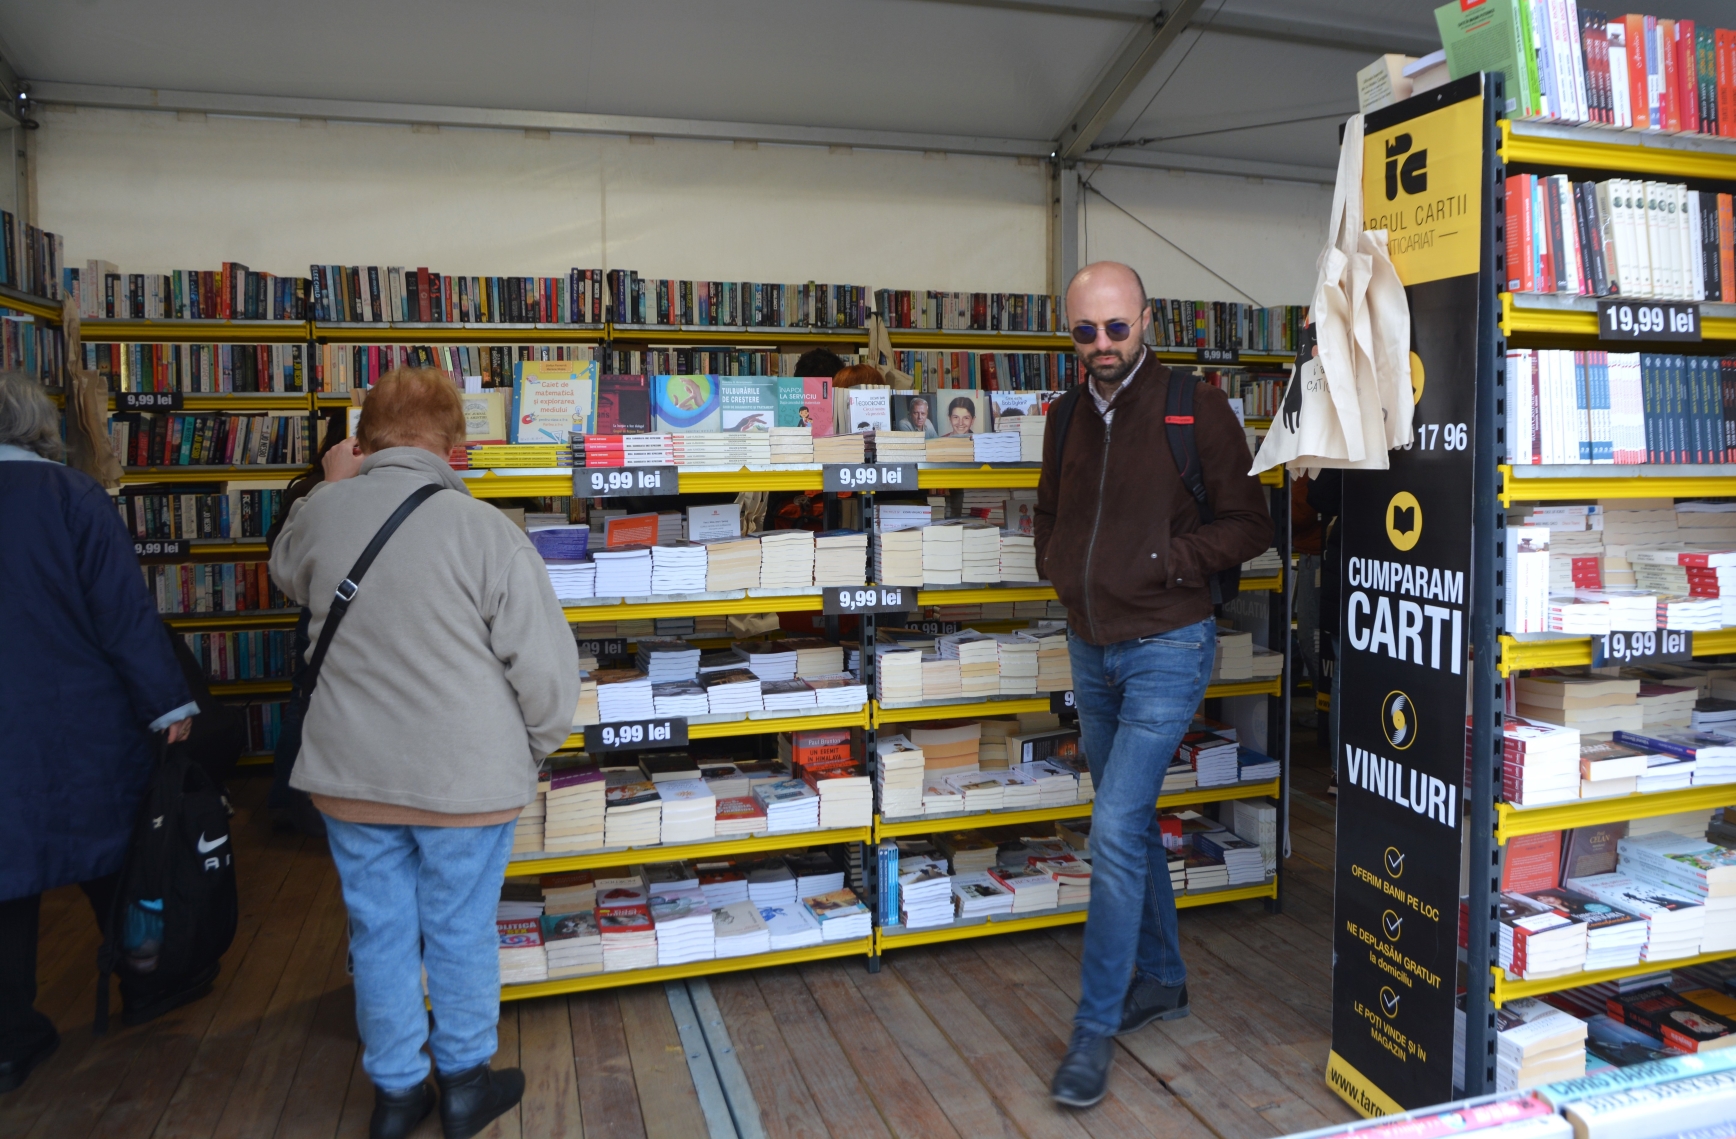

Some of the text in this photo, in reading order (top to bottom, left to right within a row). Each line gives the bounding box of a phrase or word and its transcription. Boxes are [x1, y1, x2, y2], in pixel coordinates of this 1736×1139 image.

[1362, 193, 1468, 233] ARGUL CARTII
[1388, 228, 1435, 256] NTICARIAT
[1606, 305, 1694, 336] 19,99 lei
[1204, 350, 1232, 360] 9,99 lei
[127, 394, 172, 406] 9,99 lei
[540, 398, 575, 406] explorarea
[722, 386, 760, 395] TULBURĂRILE
[730, 396, 760, 404] CREȘTERE
[1418, 424, 1439, 450] 17
[1444, 423, 1468, 450] 96
[591, 470, 661, 492] 9,99 lei
[840, 467, 902, 488] 9,99 lei
[134, 543, 179, 555] 9,99 lei
[1348, 556, 1464, 604] CUMPARAM
[839, 588, 902, 610] 9,99 lei
[904, 621, 957, 634] 1999 lei
[1347, 591, 1462, 675] CARTI
[604, 640, 622, 654] lei
[1600, 630, 1686, 662] 19,99 lei
[602, 722, 671, 747] 9,99 lei
[816, 754, 842, 762] HIMALAYA
[1345, 743, 1456, 828] VINILURI
[1351, 864, 1440, 922] OFERIM BANII PE LOC
[1347, 920, 1441, 989] NE DEPLASĂM GRATUIT
[1369, 950, 1412, 988] la domiciliu
[1354, 1000, 1363, 1016] LE
[1383, 1021, 1407, 1047] VINDE
[1408, 1040, 1416, 1055] ȘI
[1417, 1043, 1427, 1063] ÎN
[1371, 1026, 1406, 1062] MAGAZIN
